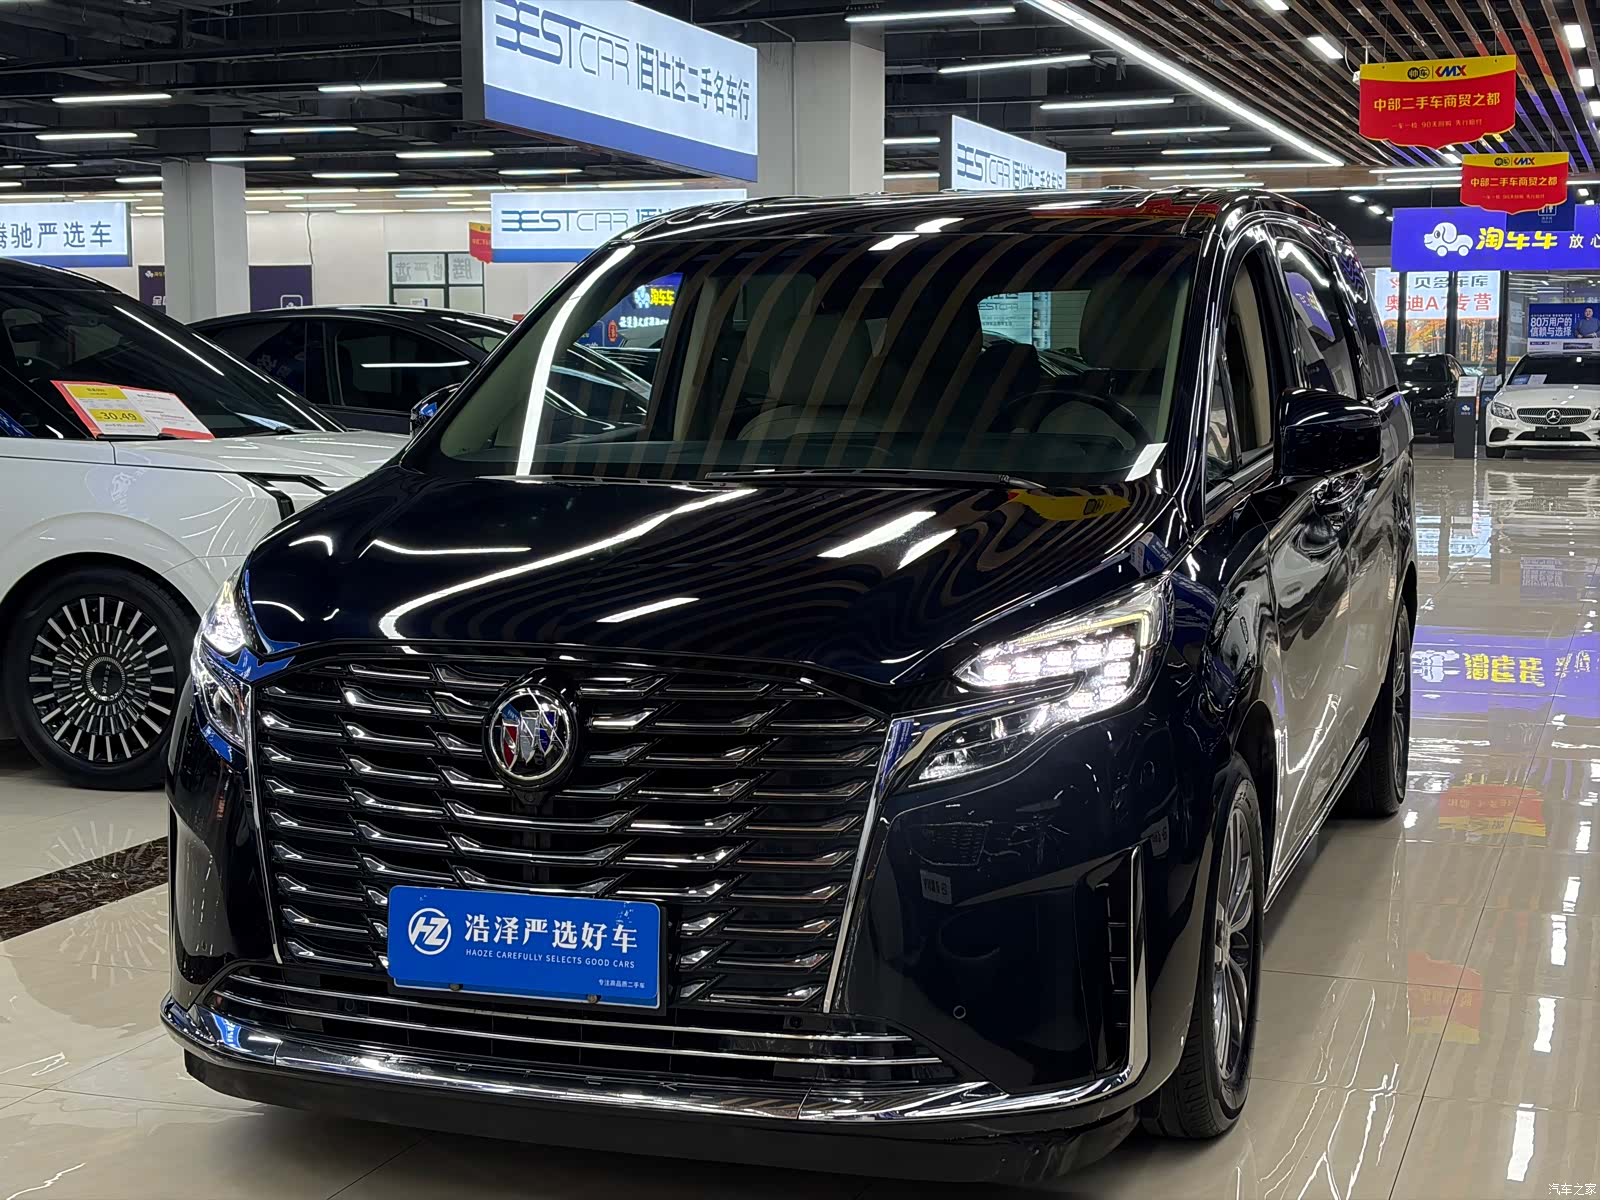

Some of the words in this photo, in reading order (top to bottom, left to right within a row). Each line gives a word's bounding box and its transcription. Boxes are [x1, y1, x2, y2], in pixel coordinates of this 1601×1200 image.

[636, 42, 750, 121] 佰仕达二手名车行
[1373, 92, 1501, 112] 中部二手车商贸之都
[1470, 176, 1558, 187] 中部二手车商贸之都
[1530, 317, 1573, 327] 80万用户的
[100, 411, 138, 421] 30.49
[464, 913, 638, 954] 浩泽严选好车
[465, 948, 494, 958] HAOZE
[496, 950, 543, 962] CAREFULLY
[545, 954, 583, 965] SELECTS
[584, 957, 611, 968] GOOD
[612, 959, 636, 969] CARS
